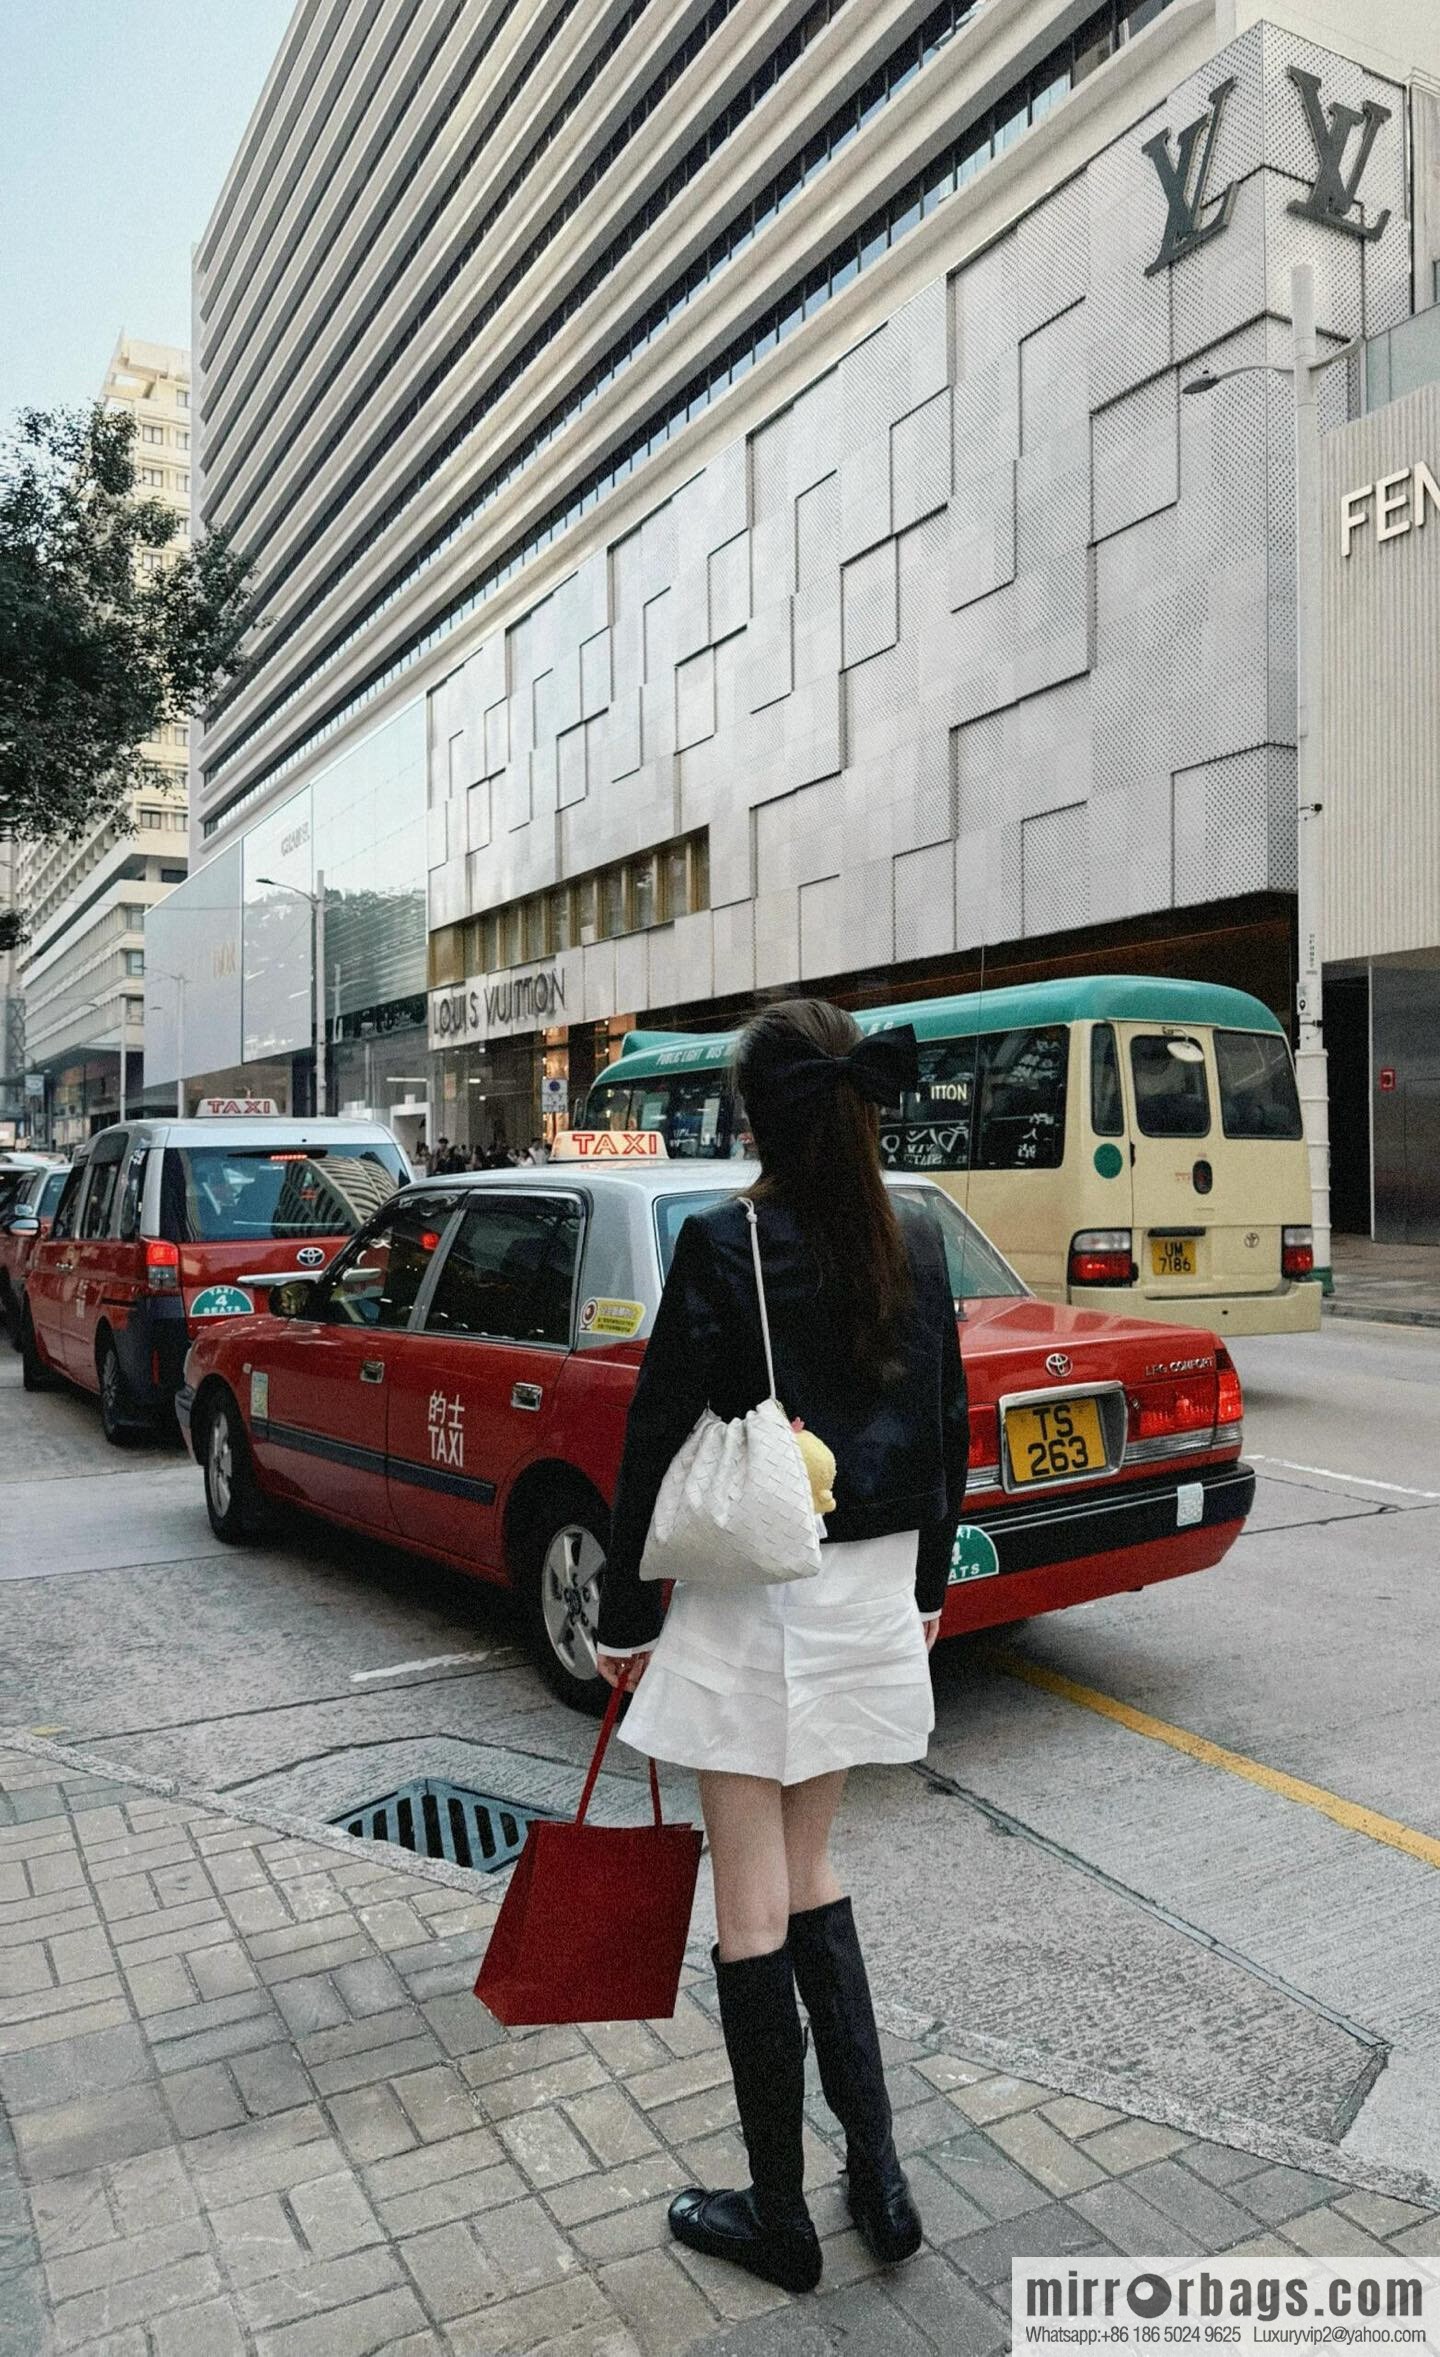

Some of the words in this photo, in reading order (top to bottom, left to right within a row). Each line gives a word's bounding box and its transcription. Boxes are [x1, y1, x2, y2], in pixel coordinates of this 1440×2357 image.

[433, 992, 480, 1035] LOUIS
[484, 967, 566, 1025] VUITTON
[207, 1100, 270, 1114] TAXI
[572, 1134, 657, 1155] TAXI
[1165, 1241, 1183, 1257] UM
[1159, 1257, 1191, 1273] 7186
[215, 1294, 228, 1307] 4
[428, 1389, 465, 1430] 的士
[1033, 1404, 1074, 1441] TS
[428, 1425, 464, 1468] TAXI
[1027, 1436, 1089, 1477] 263
